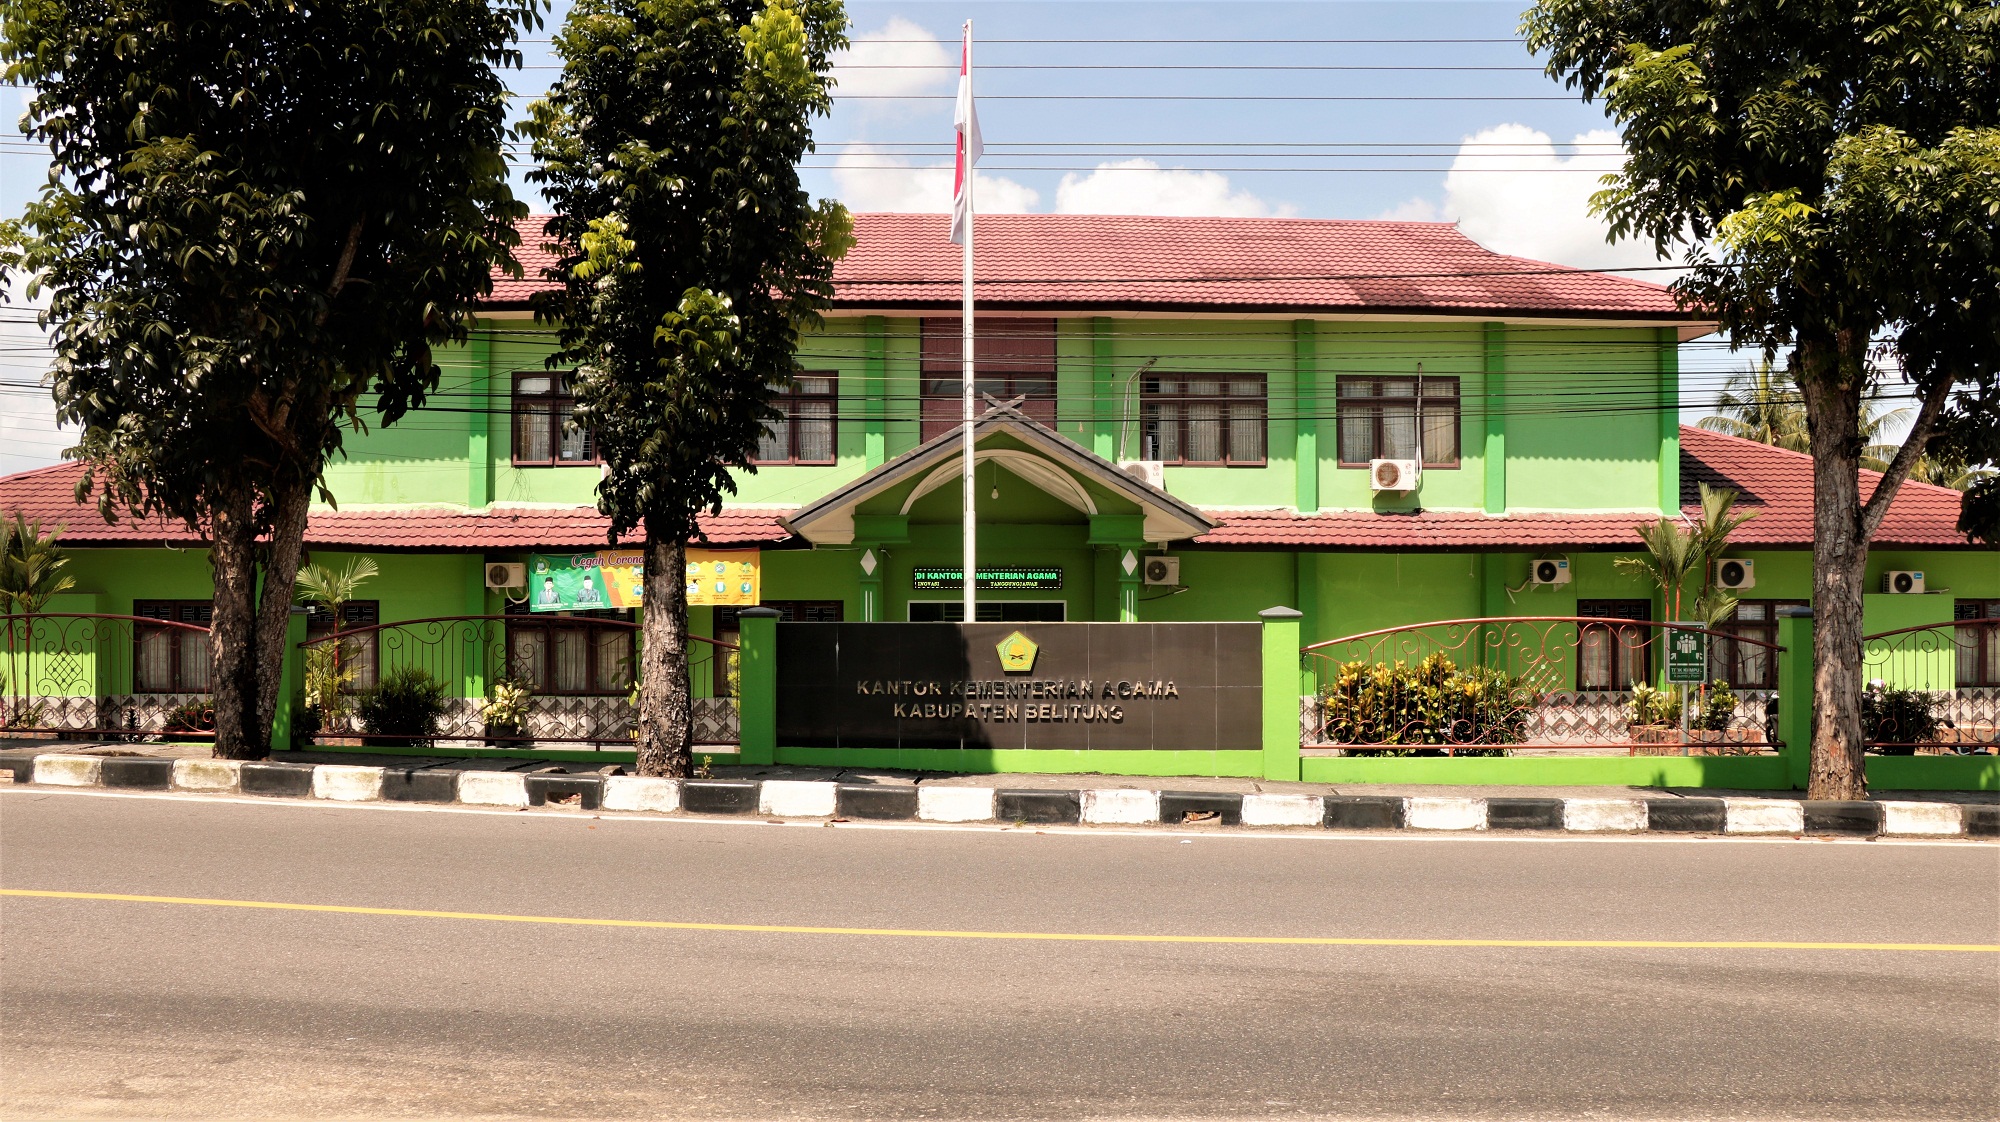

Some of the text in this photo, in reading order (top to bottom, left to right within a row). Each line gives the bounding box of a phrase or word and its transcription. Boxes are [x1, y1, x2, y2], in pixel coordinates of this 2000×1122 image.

[571, 554, 605, 571] Cegah
[857, 680, 1179, 699] KANTOR KEMENTERIAN AGAMA
[893, 703, 1124, 721] KABUPATEN BELITUNG
